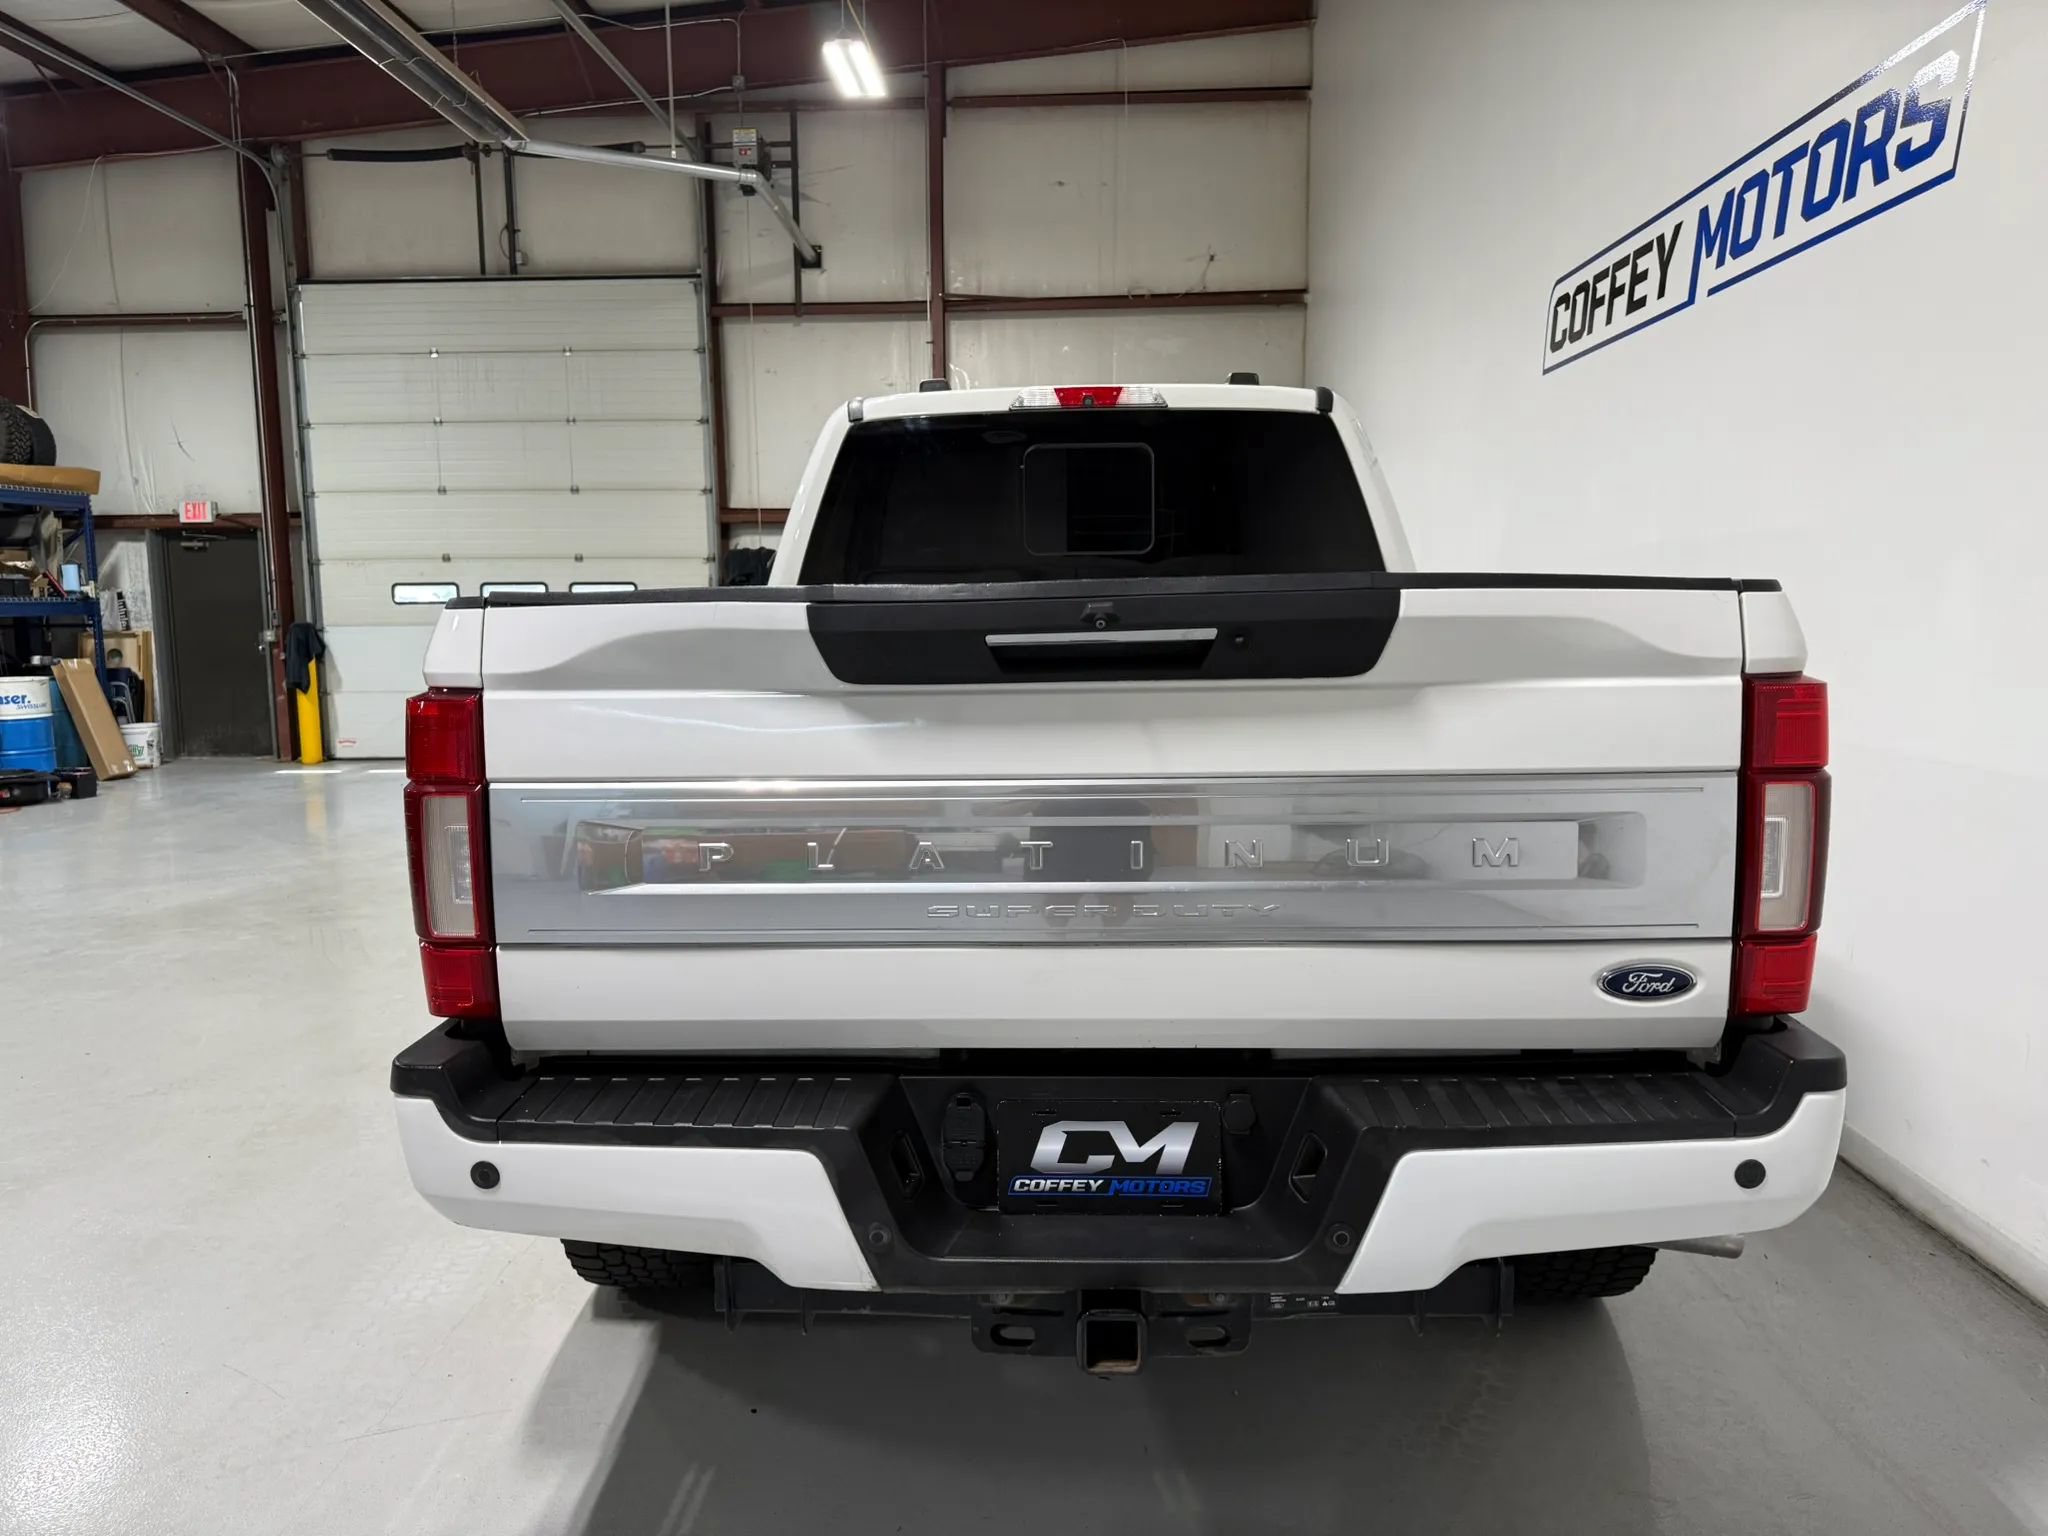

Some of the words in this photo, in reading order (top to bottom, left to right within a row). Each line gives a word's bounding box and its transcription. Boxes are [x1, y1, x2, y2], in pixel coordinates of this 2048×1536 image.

[1550, 220, 1684, 353] COFFEY
[1688, 49, 1961, 304] MOTORS
[185, 502, 208, 519] EXIT
[698, 837, 1520, 872] PLATINUM
[927, 904, 1118, 918] SUPER
[1133, 903, 1281, 917] DUTY
[1622, 971, 1676, 993] Ford
[1030, 1120, 1200, 1175] CM
[1013, 1179, 1104, 1193] COFFEY
[1108, 1179, 1207, 1195] MOTORS
